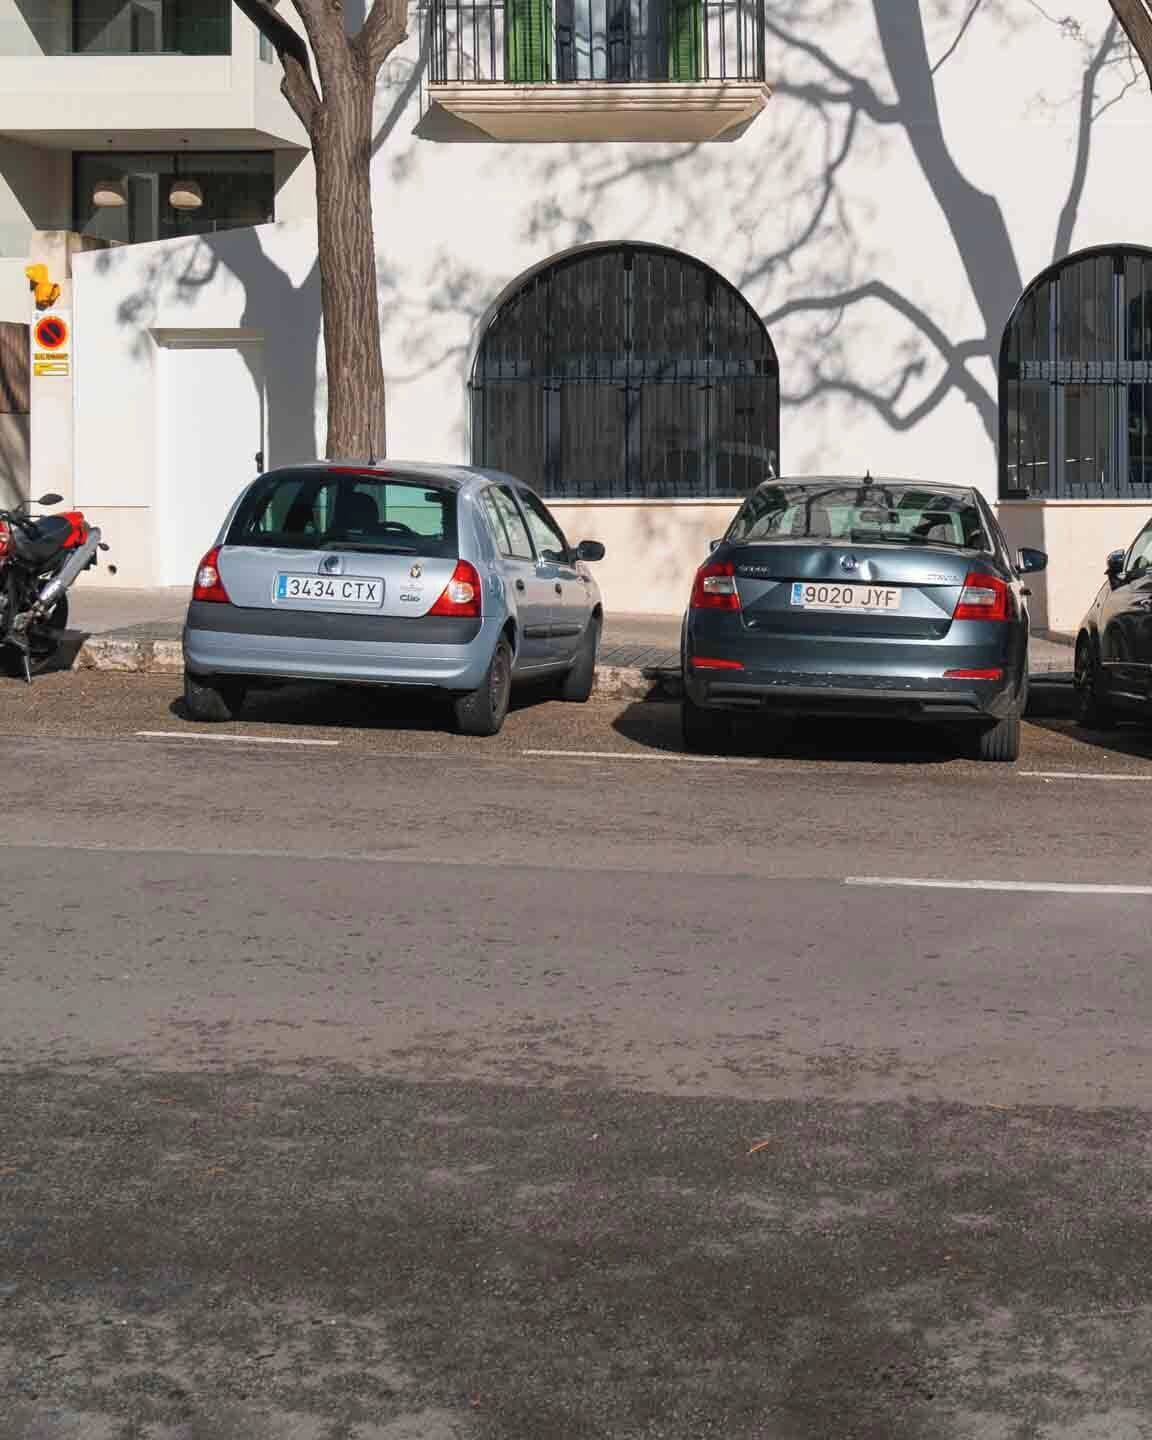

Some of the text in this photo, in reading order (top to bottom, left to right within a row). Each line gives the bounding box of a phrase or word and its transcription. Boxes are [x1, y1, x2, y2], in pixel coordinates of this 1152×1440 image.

[289, 578, 336, 597] 3434
[341, 582, 377, 601] CTX
[804, 585, 897, 608] 9020 JYF
